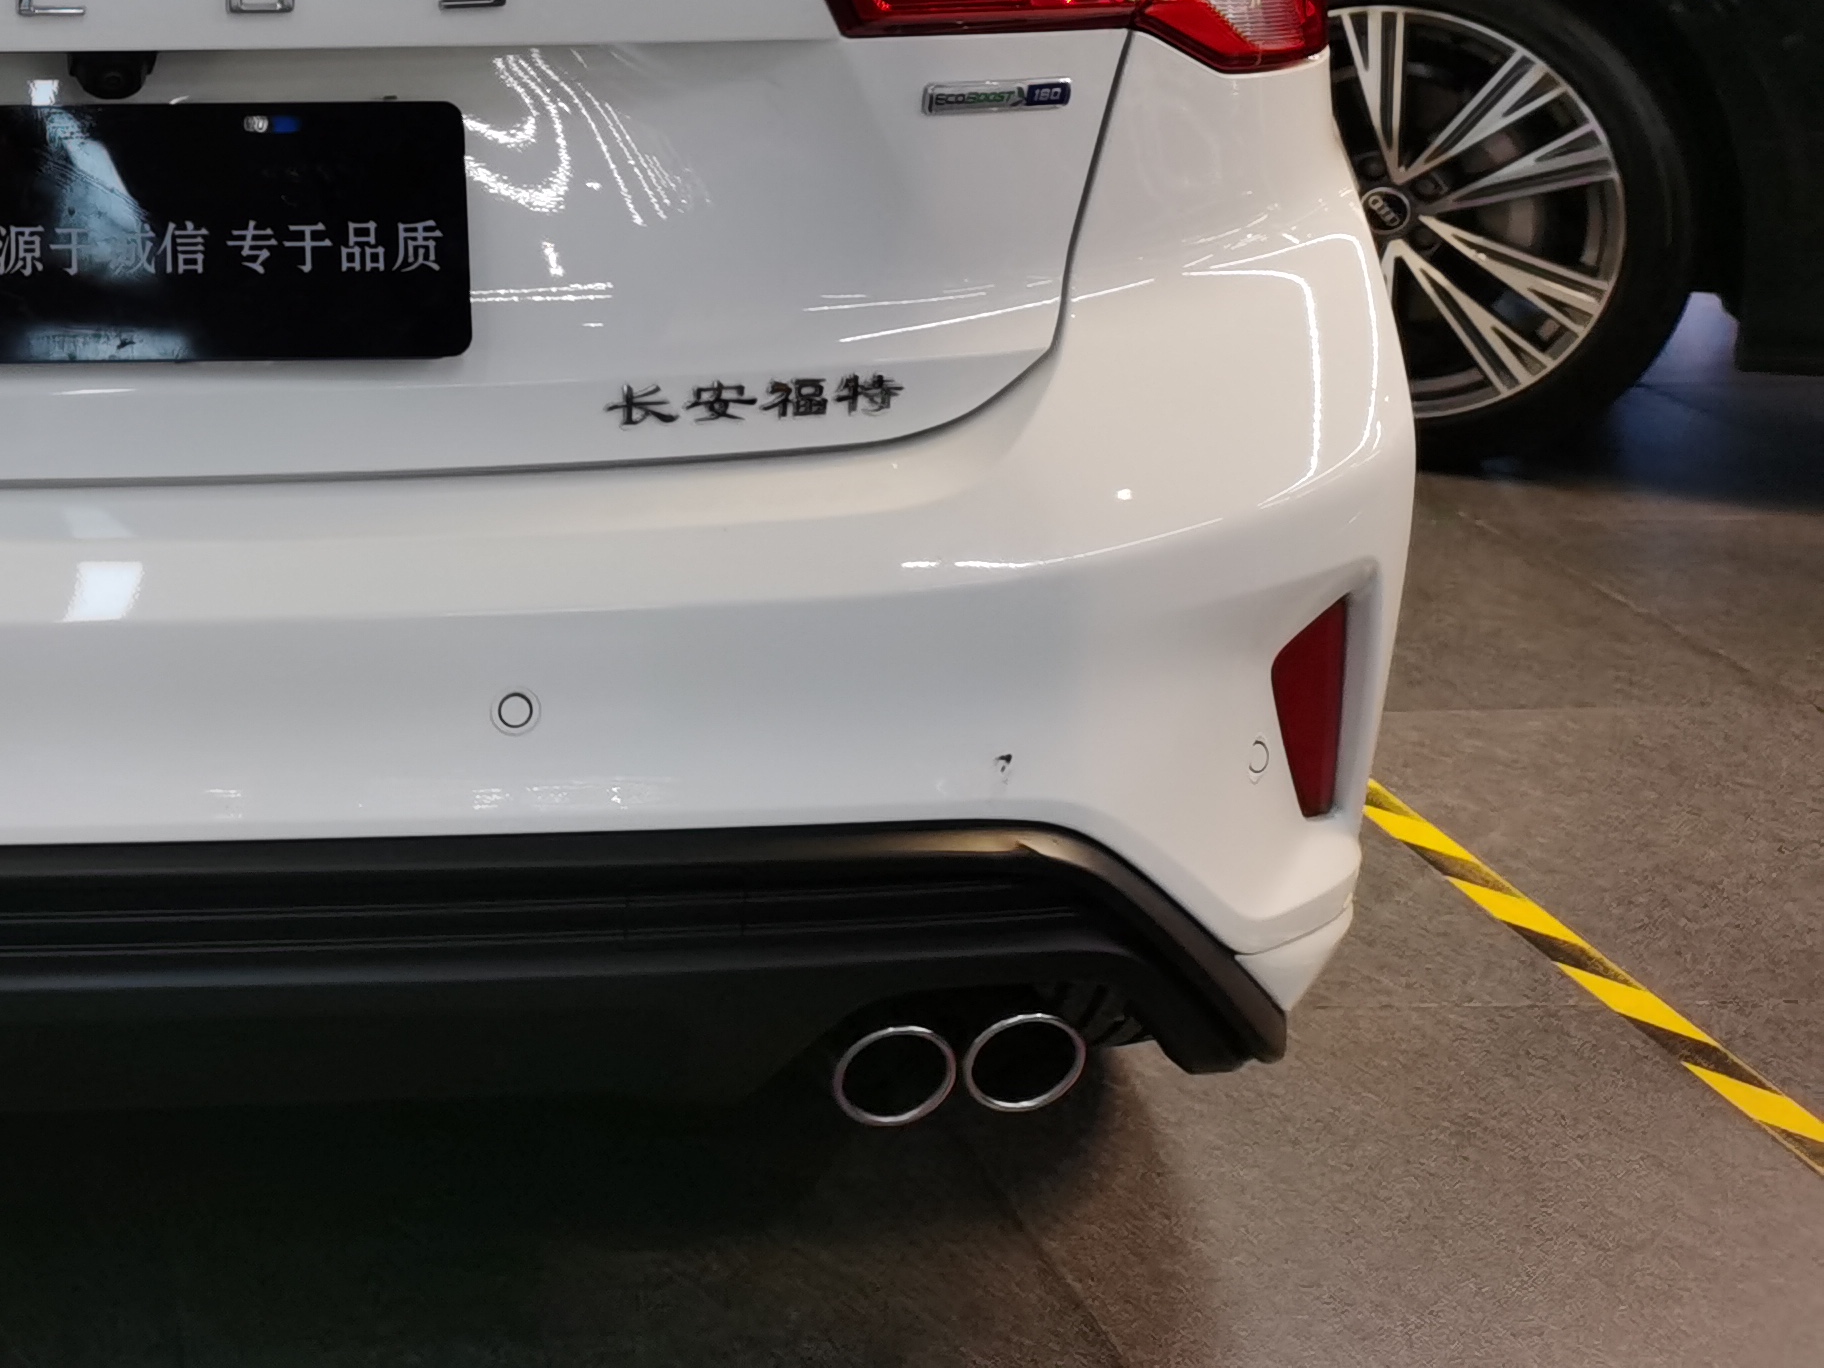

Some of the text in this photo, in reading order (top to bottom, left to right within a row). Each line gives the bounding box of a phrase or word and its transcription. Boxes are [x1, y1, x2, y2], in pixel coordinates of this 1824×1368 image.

[225, 218, 444, 275] 专于品质
[603, 371, 905, 431] 长安福特
